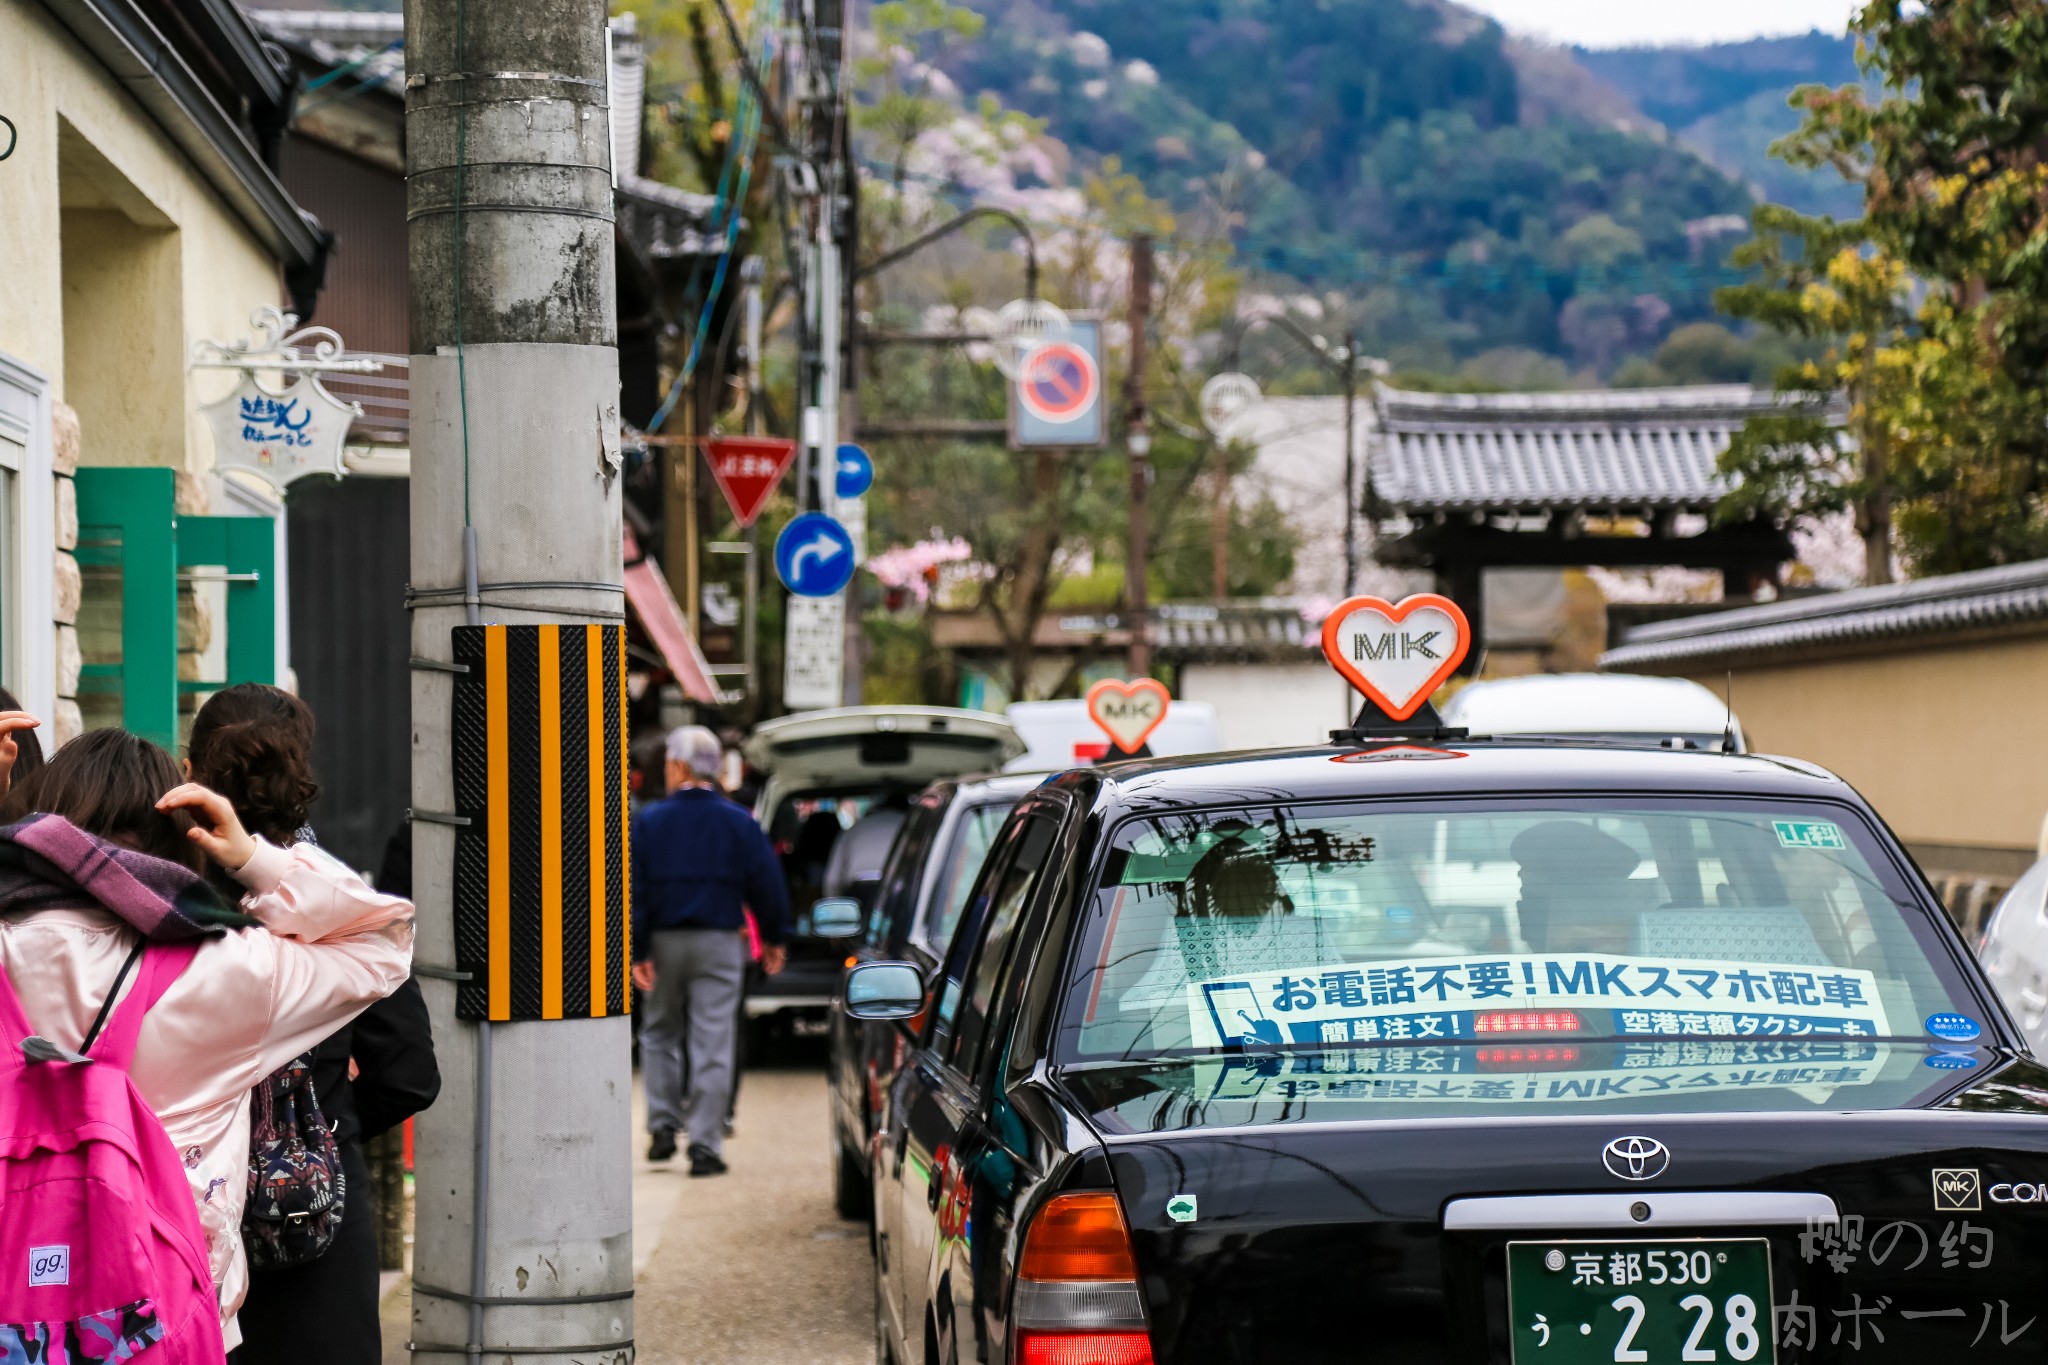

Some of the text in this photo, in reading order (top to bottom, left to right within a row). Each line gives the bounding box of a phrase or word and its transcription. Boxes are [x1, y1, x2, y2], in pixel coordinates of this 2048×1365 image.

[1354, 630, 1442, 660] MK
[1104, 703, 1152, 719] MK
[1780, 824, 1840, 847] 山科
[1272, 961, 1868, 1012] お電話不要！MKスマホ配車
[1320, 1013, 1460, 1043] 簡単注文！
[1942, 1180, 1970, 1193] MK
[1531, 1313, 1550, 1347] う
